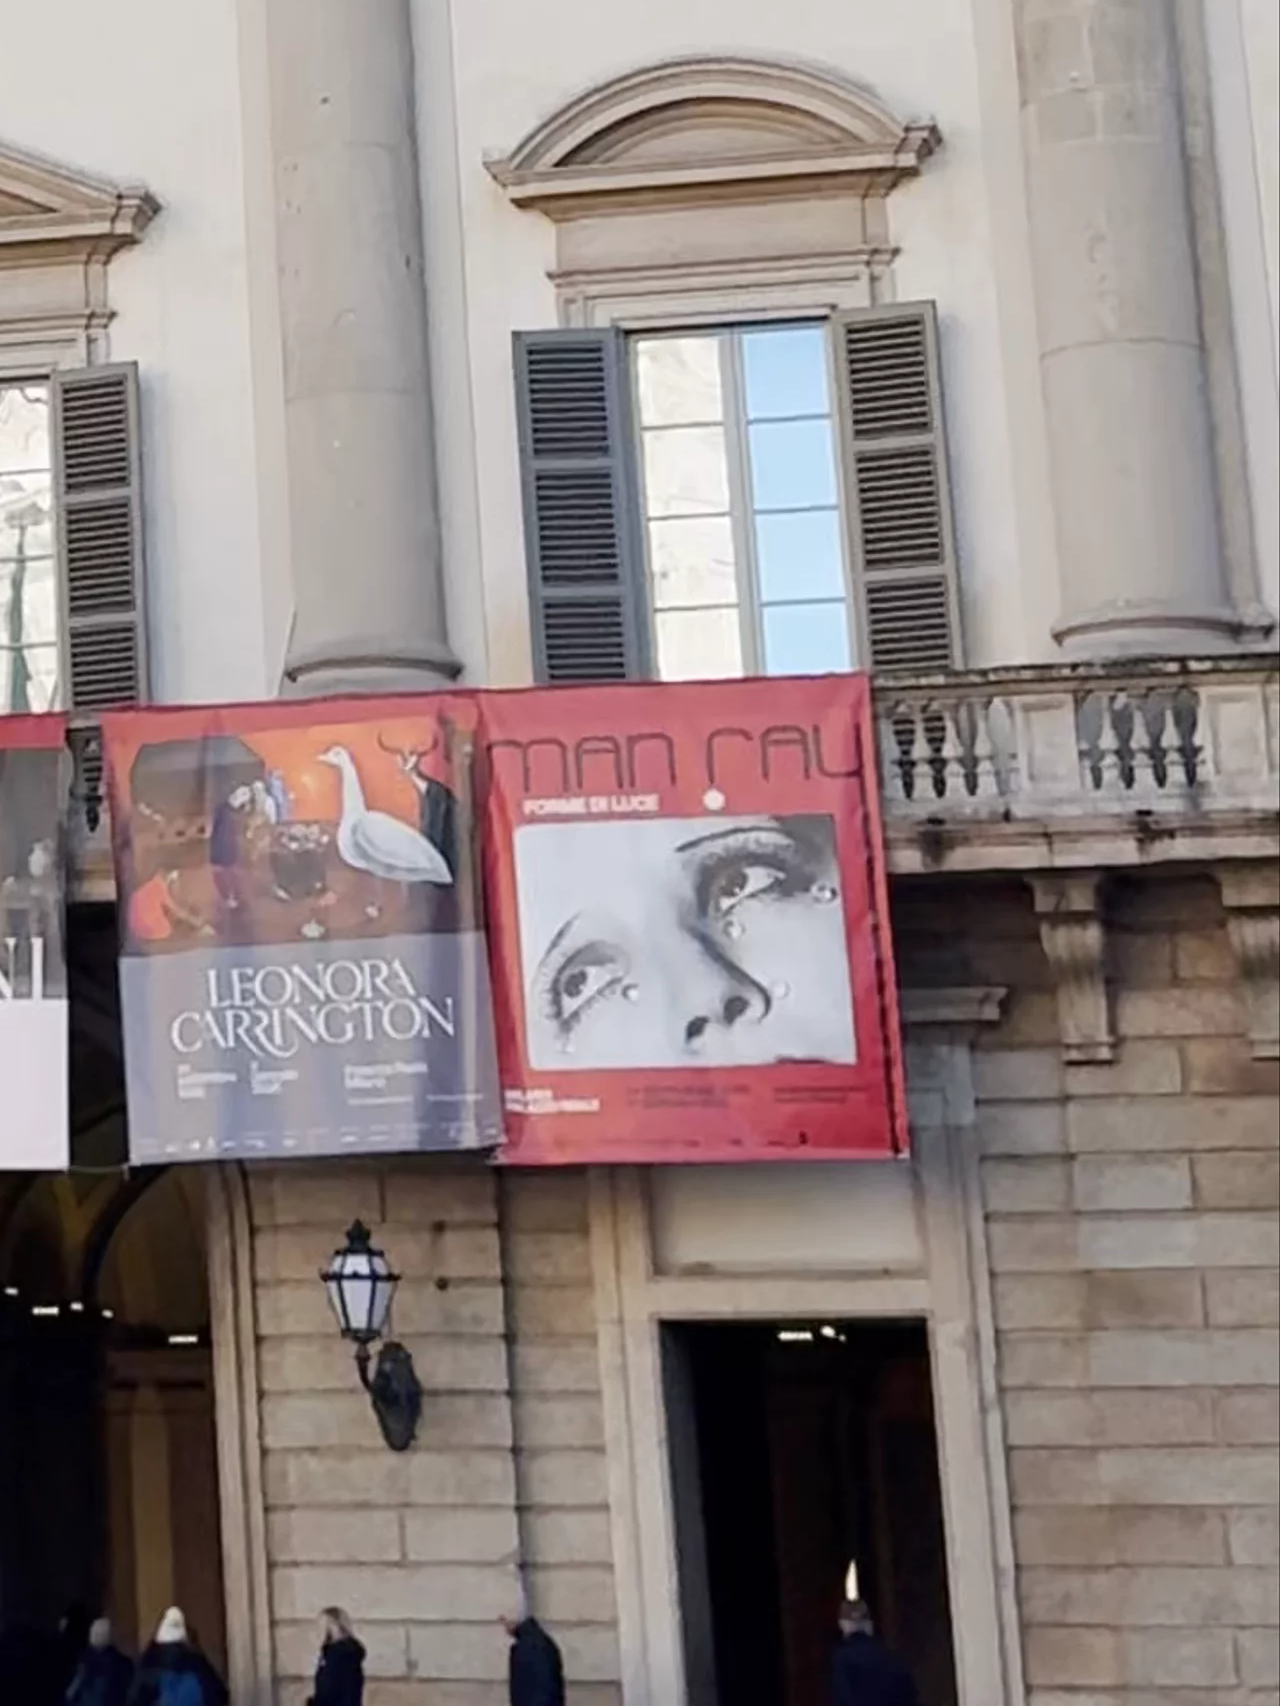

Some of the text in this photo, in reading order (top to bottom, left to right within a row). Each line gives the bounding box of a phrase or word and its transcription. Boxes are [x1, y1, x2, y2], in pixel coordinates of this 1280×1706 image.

[588, 795, 608, 814] DI
[610, 793, 659, 813] LUCE
[207, 958, 417, 1008] LEONORA
[170, 996, 455, 1059] CARRINGTON
